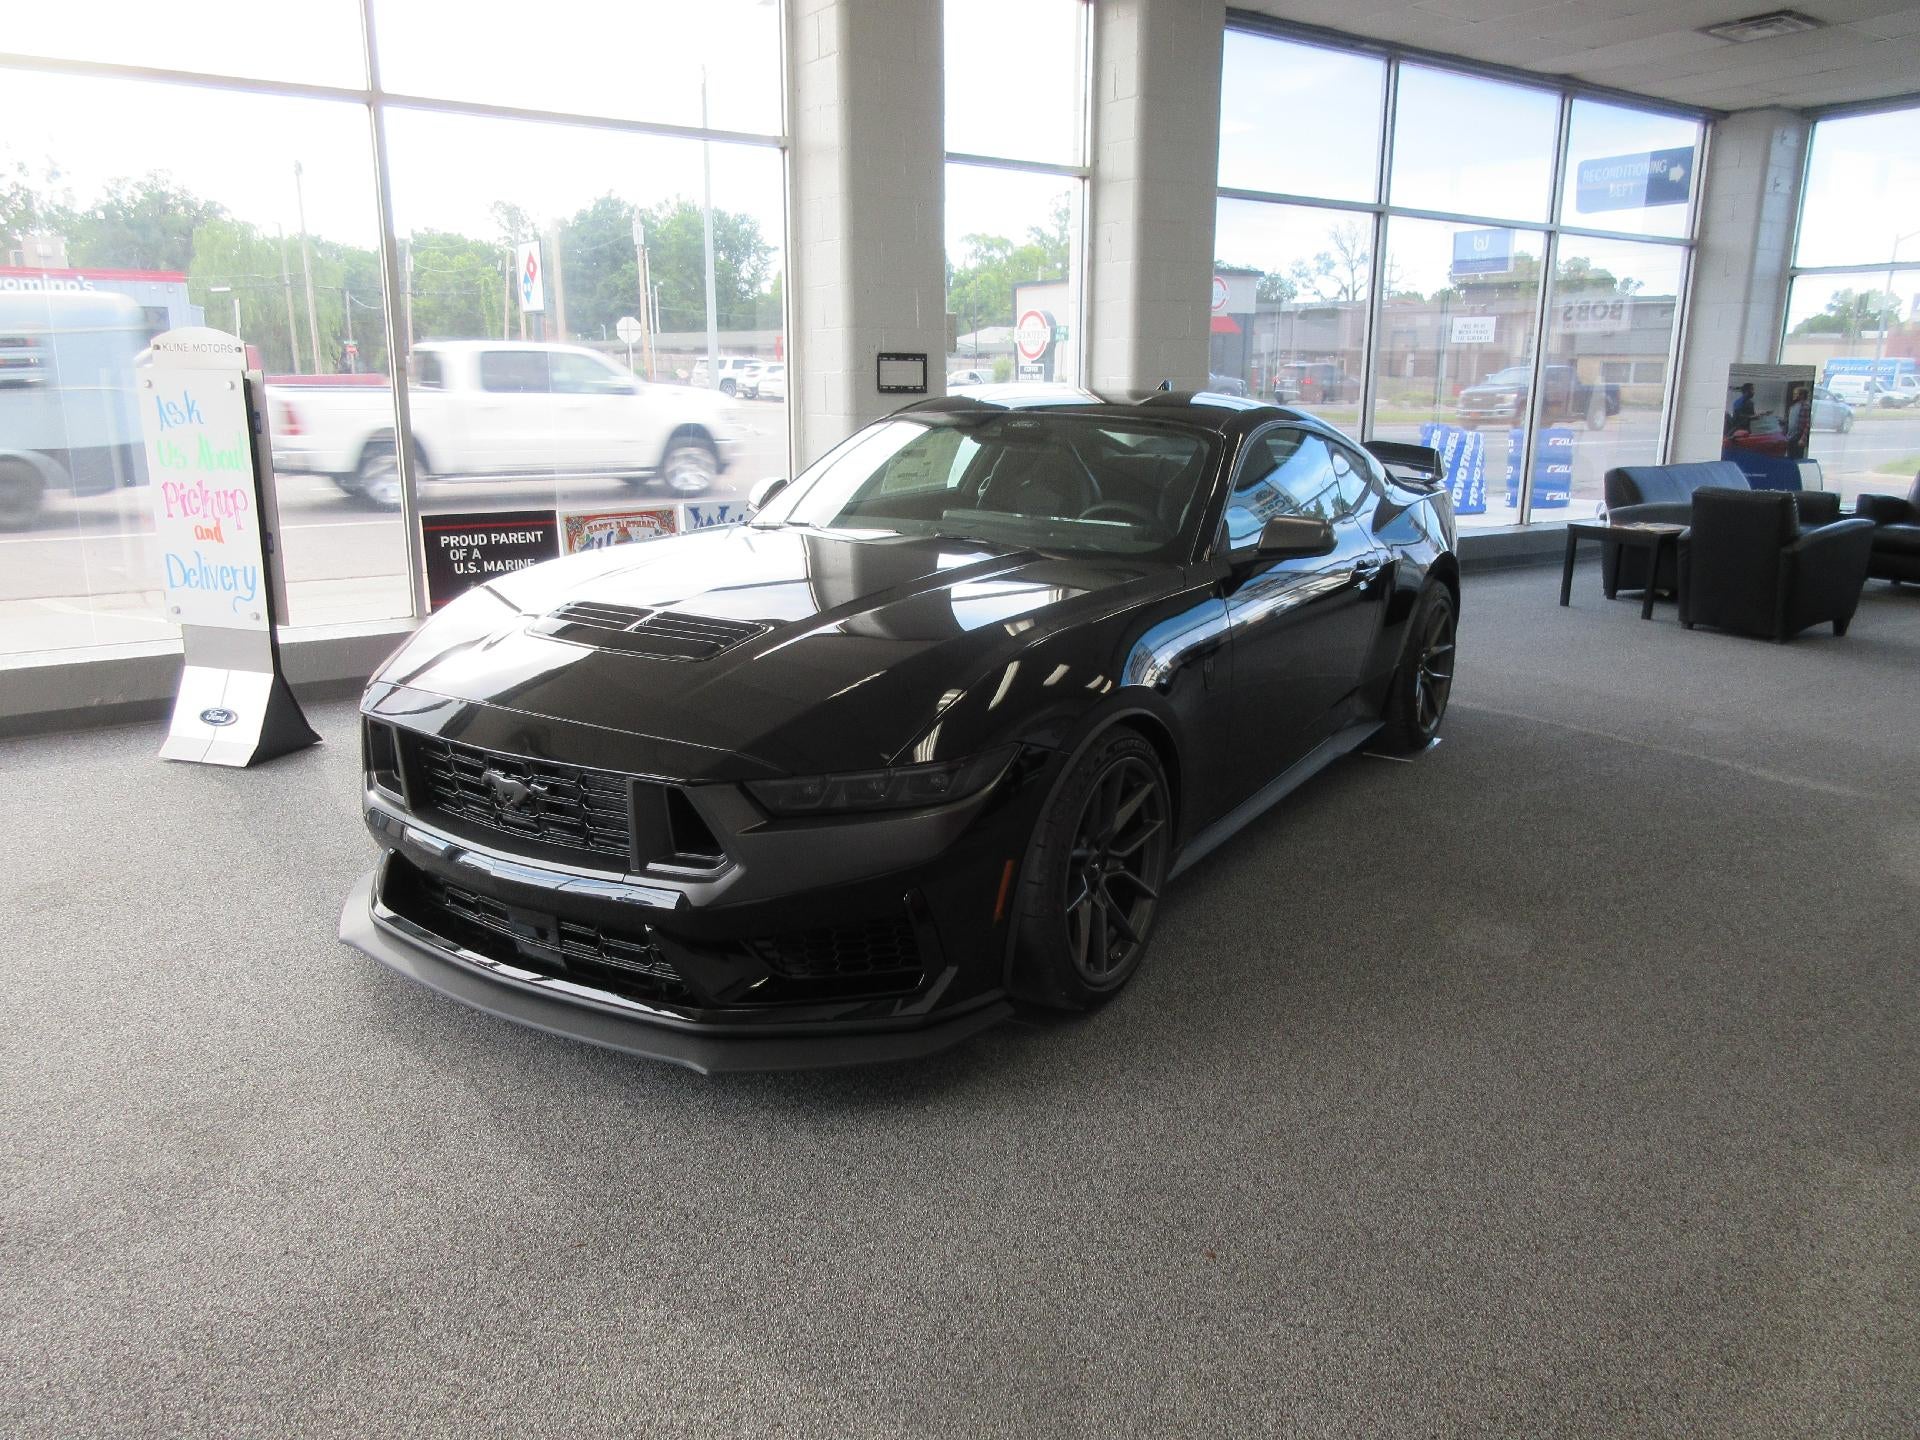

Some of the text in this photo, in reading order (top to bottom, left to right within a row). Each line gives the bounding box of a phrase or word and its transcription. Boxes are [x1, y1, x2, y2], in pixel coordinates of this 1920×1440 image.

[1582, 159, 1668, 184] RECONDITIONING
[0, 274, 96, 291] omino's
[162, 343, 234, 354] KLINE MOTORS
[156, 390, 205, 431] Ask
[157, 432, 249, 472] Us About
[162, 480, 249, 531] Pickup
[194, 519, 225, 544] and
[587, 519, 657, 533] HAPPY BIRTHDAY
[440, 531, 544, 548] PROUD PARENT
[449, 548, 482, 561] OF A
[454, 562, 481, 575] U.S.
[165, 550, 258, 614] Delivery
